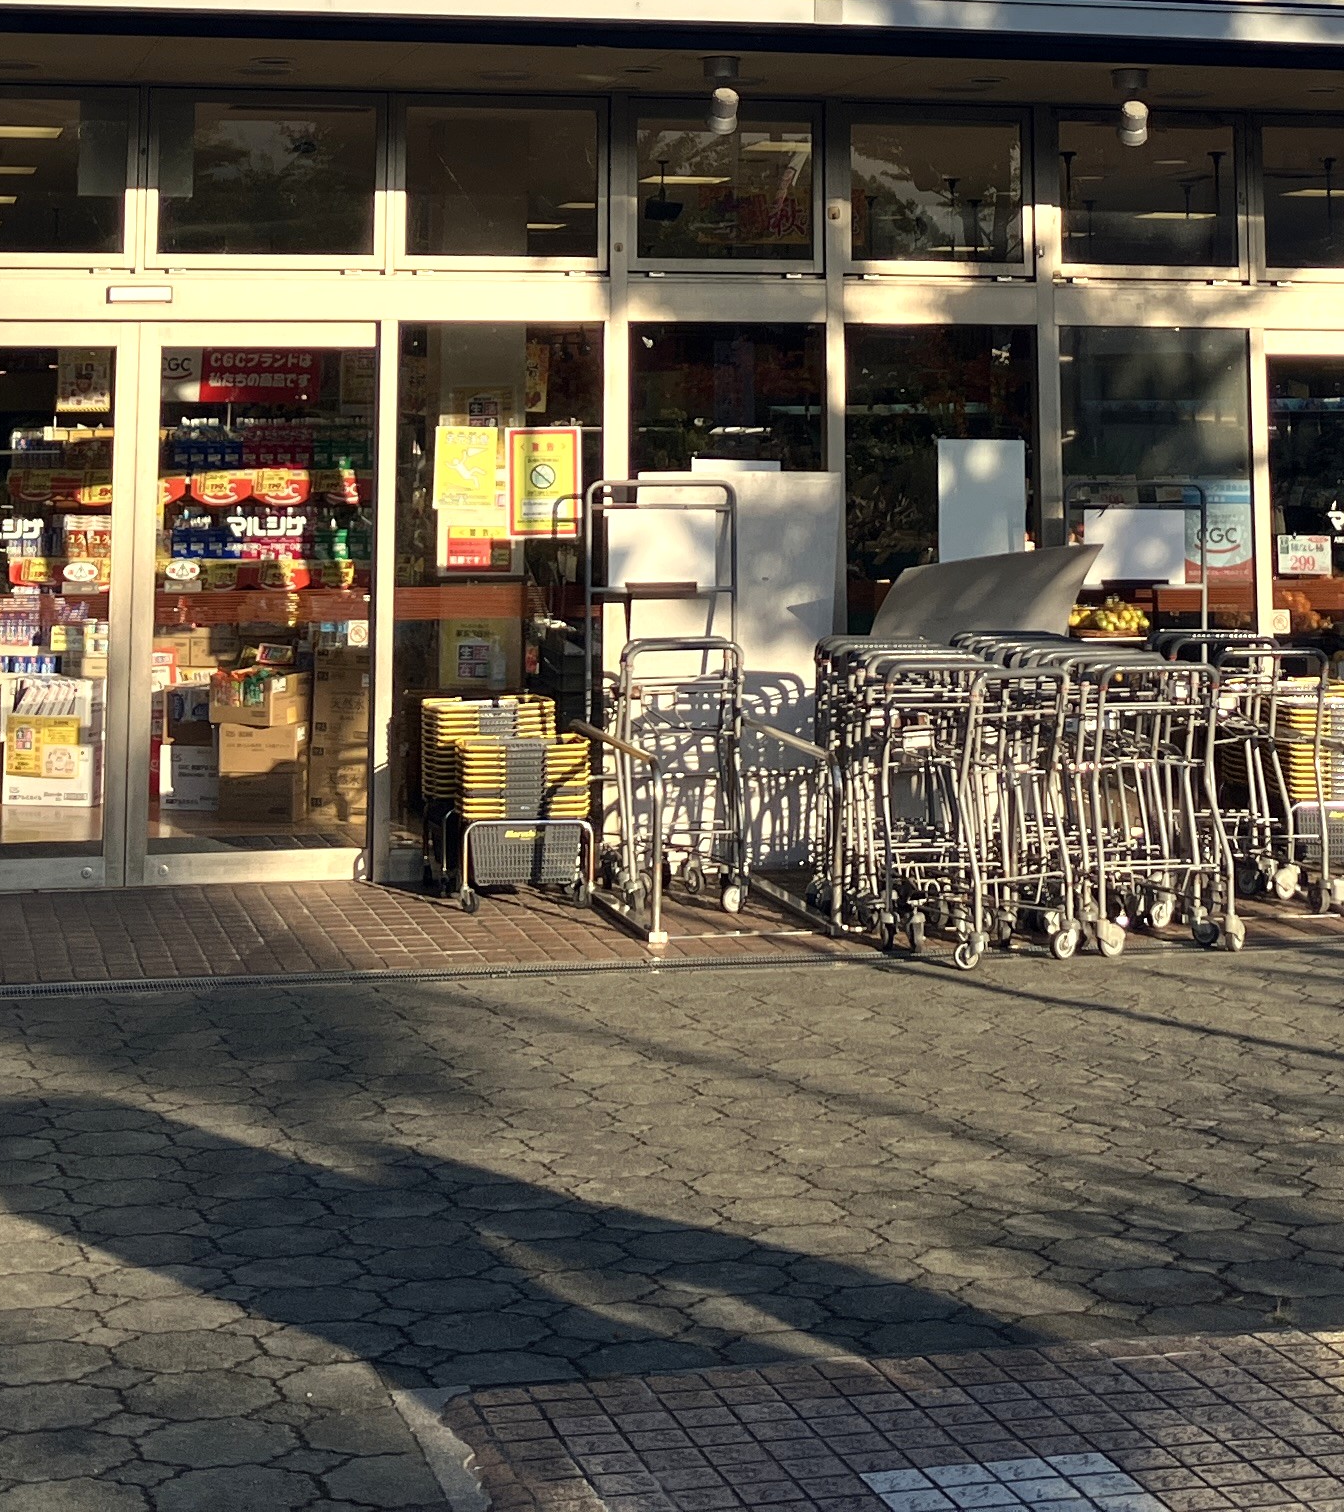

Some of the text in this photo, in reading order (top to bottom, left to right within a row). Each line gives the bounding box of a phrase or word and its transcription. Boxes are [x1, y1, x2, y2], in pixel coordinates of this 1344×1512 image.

[210, 352, 312, 368] CGCブランドは
[208, 372, 311, 387] 私たちの商品です
[226, 515, 307, 537] マルシゲ
[1196, 527, 1237, 544] CGC
[1290, 555, 1316, 571] 299
